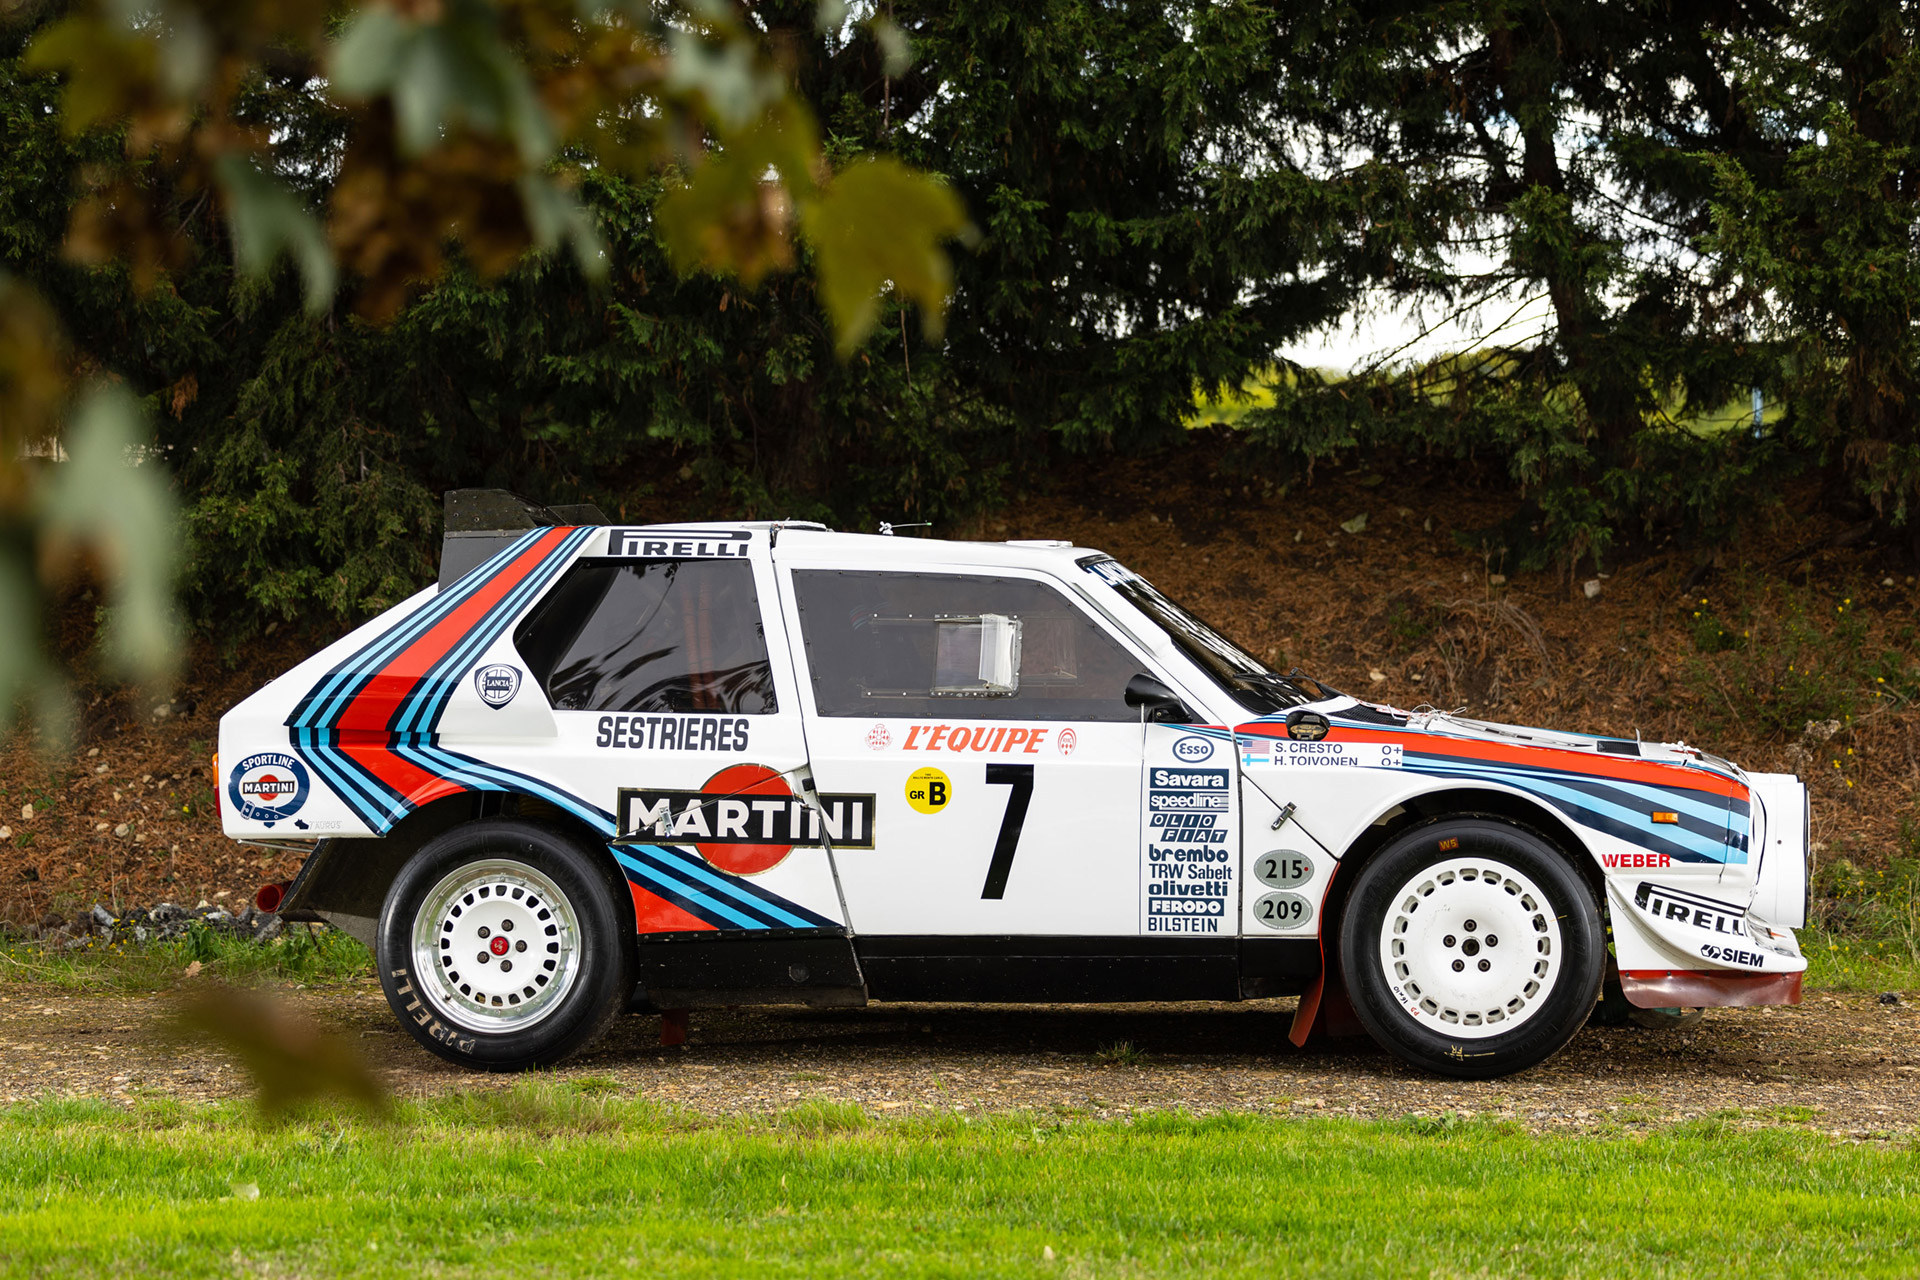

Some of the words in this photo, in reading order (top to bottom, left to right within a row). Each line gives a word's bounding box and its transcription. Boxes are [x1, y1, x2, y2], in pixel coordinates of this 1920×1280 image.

[607, 529, 753, 557] PIRELLI
[487, 679, 510, 687] LANCIA
[596, 716, 749, 752] SESTRIERES
[902, 724, 1049, 754] L'ÉQUIPE
[1179, 743, 1209, 755] Esso
[1275, 742, 1287, 753] S.
[1289, 742, 1343, 754] CRESTO
[242, 754, 296, 771] SPORTLINE
[1274, 755, 1287, 766] H.
[1288, 755, 1358, 766] TOIVONEN
[1154, 769, 1224, 787] Savara
[244, 782, 294, 794] MARTINI
[909, 790, 925, 800] GR
[929, 781, 947, 806] B
[1150, 792, 1221, 810] speedline
[628, 796, 864, 840] MARTINI
[1153, 814, 1213, 826] OLIO
[980, 763, 1035, 900] 7
[1164, 829, 1225, 841] FIAT
[1439, 839, 1457, 849] W5
[1148, 843, 1229, 863] brembo
[1601, 853, 1671, 868] WEBER
[1148, 863, 1184, 879] TRW
[1187, 863, 1233, 880] Sabelt
[1265, 859, 1303, 879] 215
[1148, 880, 1228, 897] olivetti
[1151, 899, 1222, 914] FERODO
[1262, 900, 1303, 920] 209
[1148, 917, 1218, 933] BILSTEIN
[1721, 947, 1765, 968] SIEM
[391, 968, 477, 1055] PIRELLI
